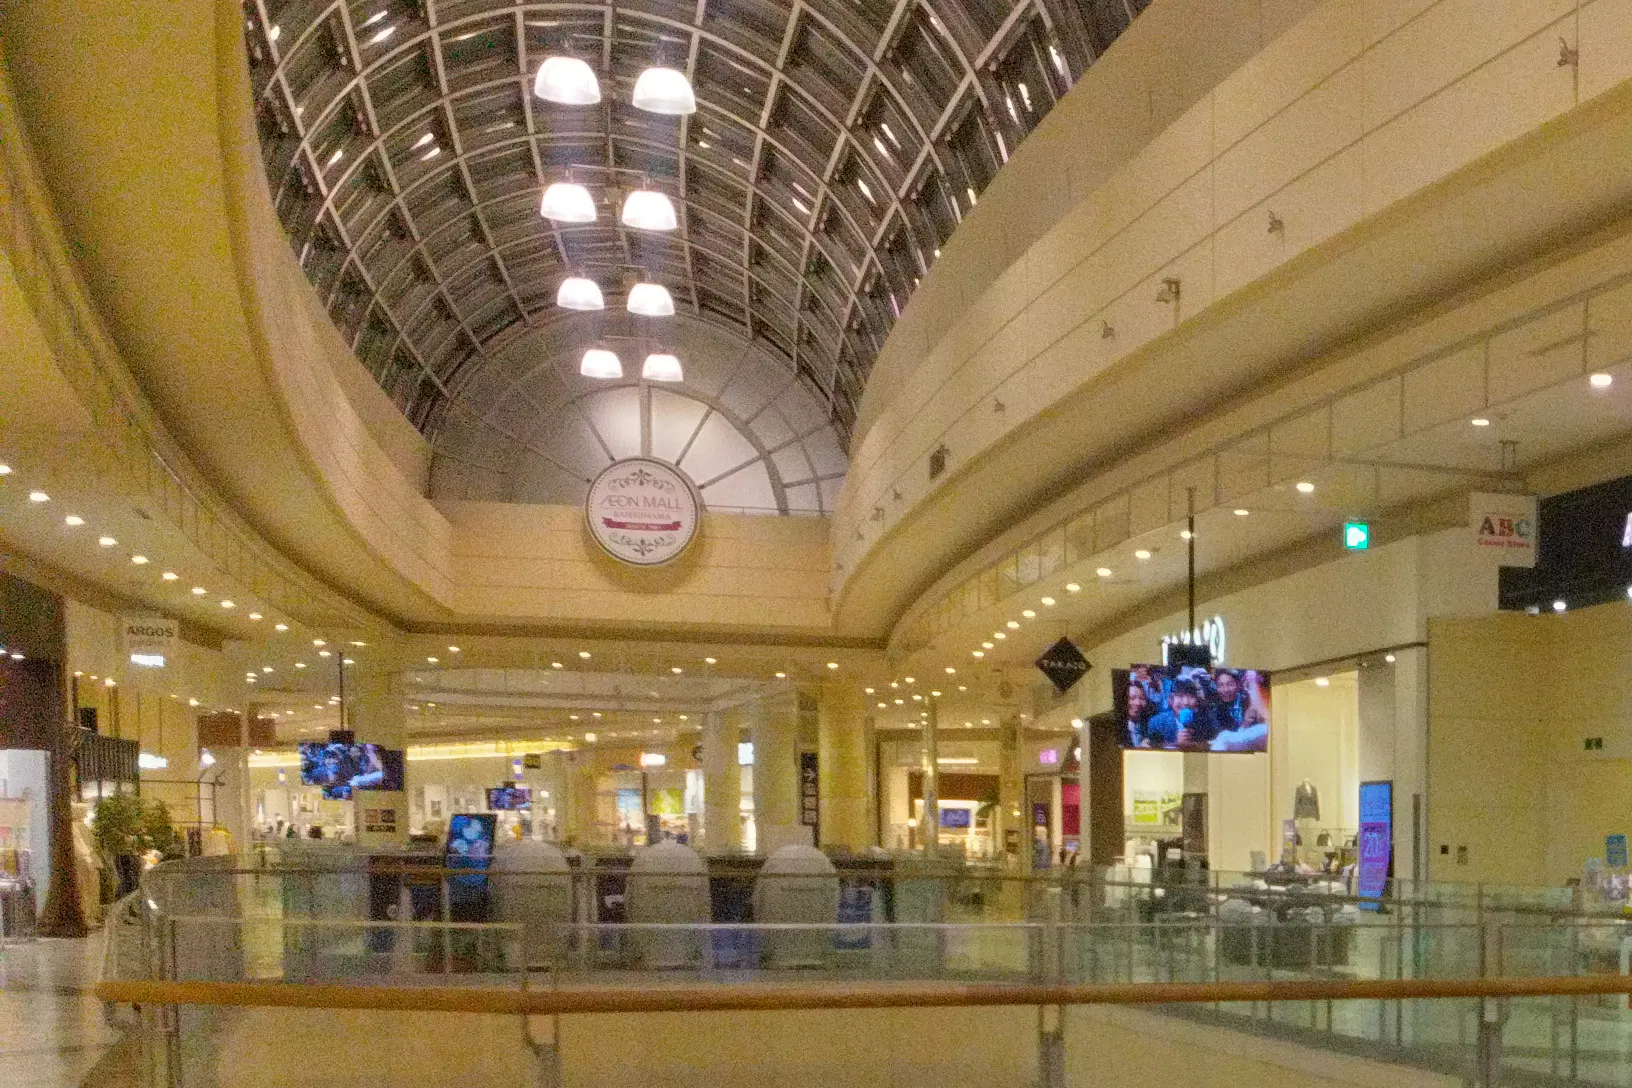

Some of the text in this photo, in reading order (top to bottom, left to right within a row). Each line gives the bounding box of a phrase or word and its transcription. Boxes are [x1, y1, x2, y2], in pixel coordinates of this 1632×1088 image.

[643, 496, 684, 510] MALL
[1478, 515, 1534, 539] ABC
[126, 625, 174, 638] ARGOS
